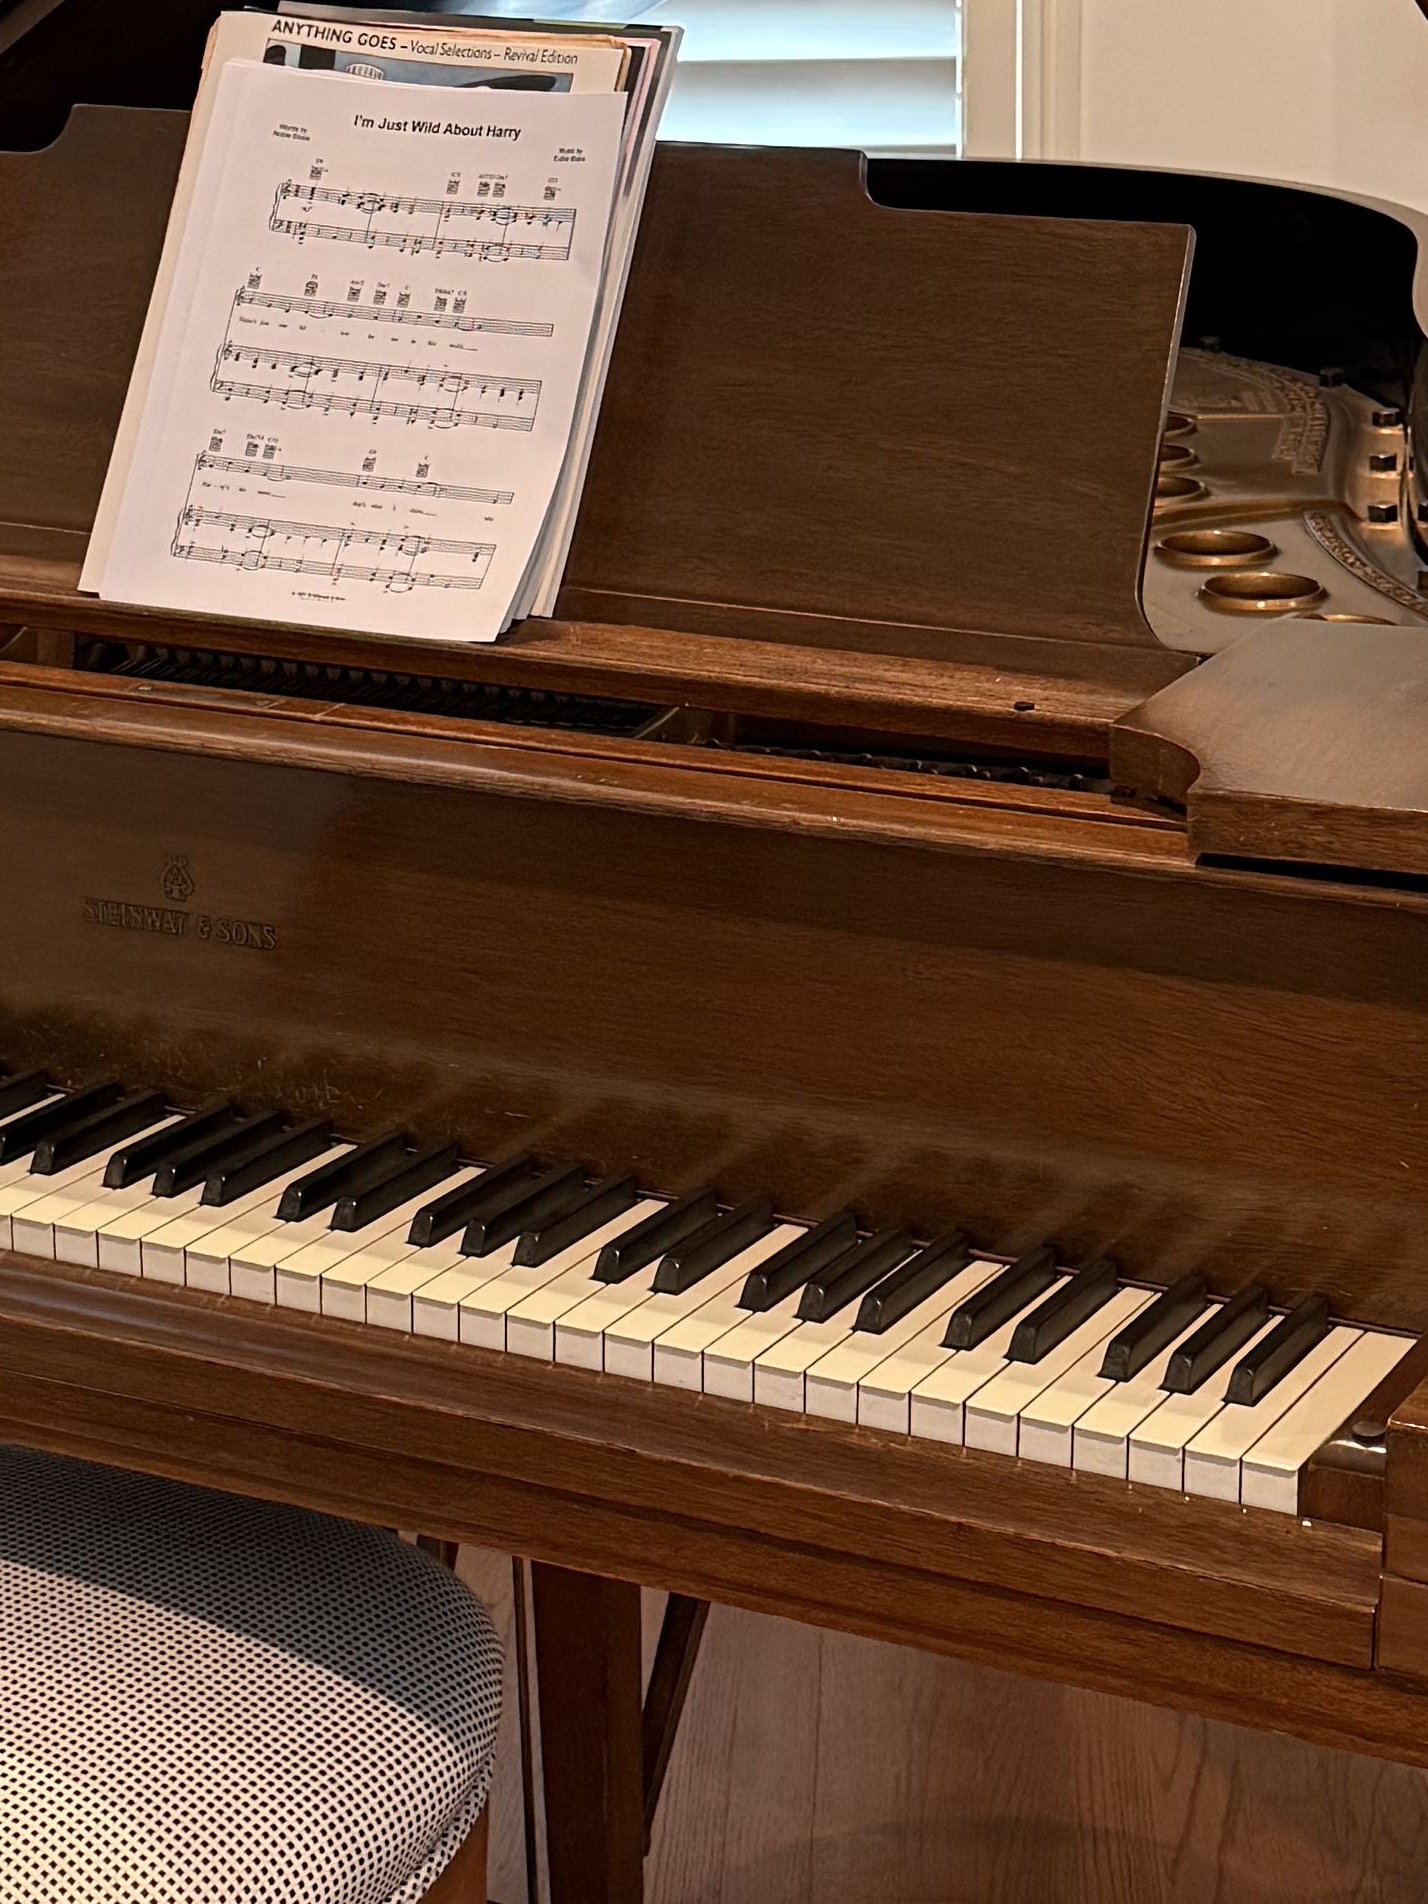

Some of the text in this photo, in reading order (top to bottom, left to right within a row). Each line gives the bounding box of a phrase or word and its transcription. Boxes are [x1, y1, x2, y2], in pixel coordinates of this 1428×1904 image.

[271, 19, 354, 44] ANYTHING
[357, 32, 398, 51] GOES
[410, 39, 439, 56] Vocal
[439, 42, 493, 60] Selections
[503, 46, 540, 63] Revival
[540, 49, 579, 65] Edition
[353, 114, 522, 142] I'm Just Wild About Harry
[217, 919, 277, 949] SONS
